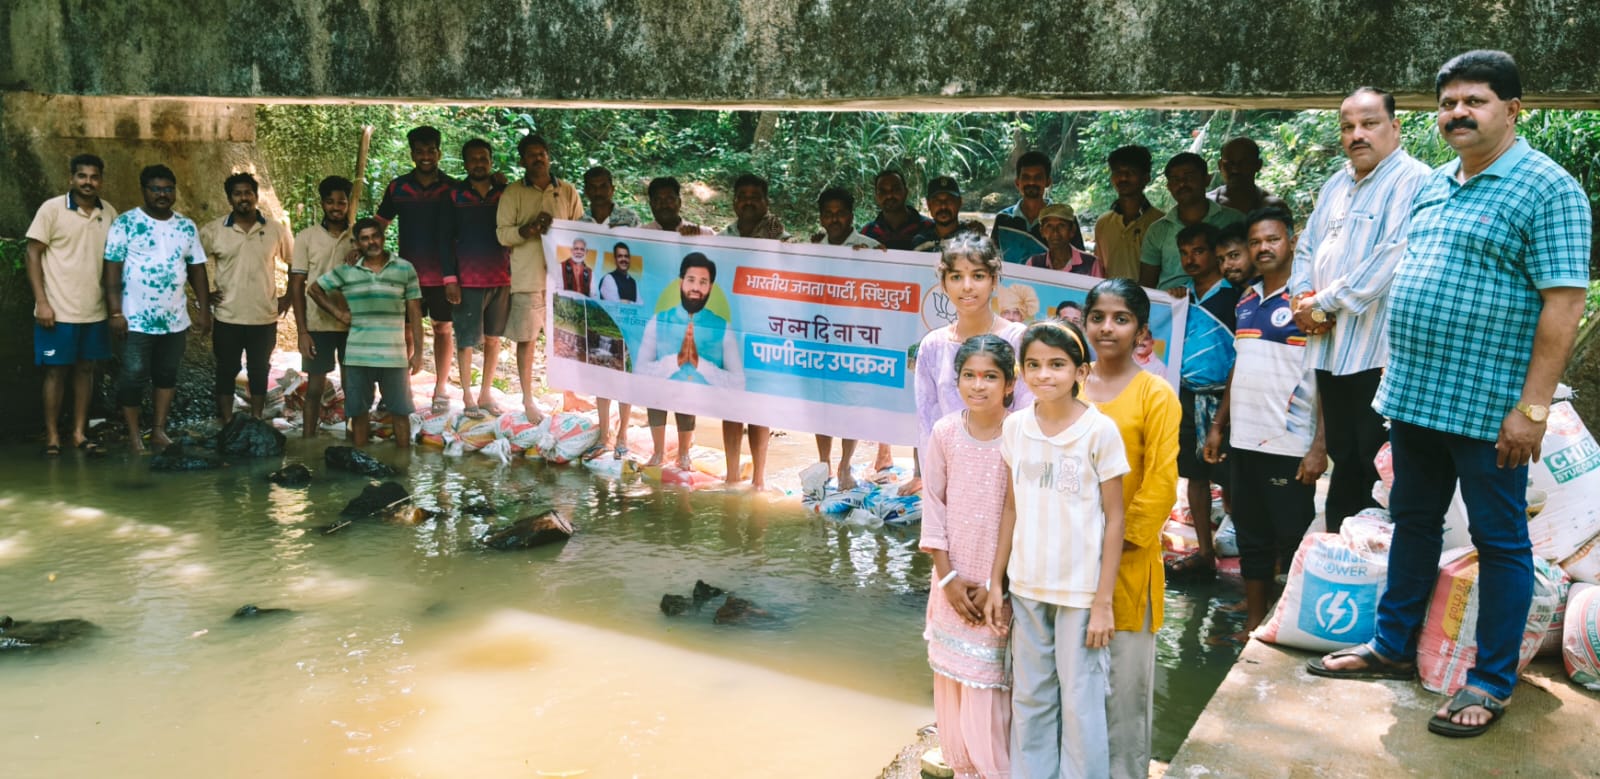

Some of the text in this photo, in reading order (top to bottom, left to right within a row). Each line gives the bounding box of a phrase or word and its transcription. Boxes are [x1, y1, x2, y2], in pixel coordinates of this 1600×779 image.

[746, 272, 912, 309] भारतीय जनता पार्टी, सिंधुदुर्ग
[751, 340, 898, 377] पाणीदार उपक्रम
